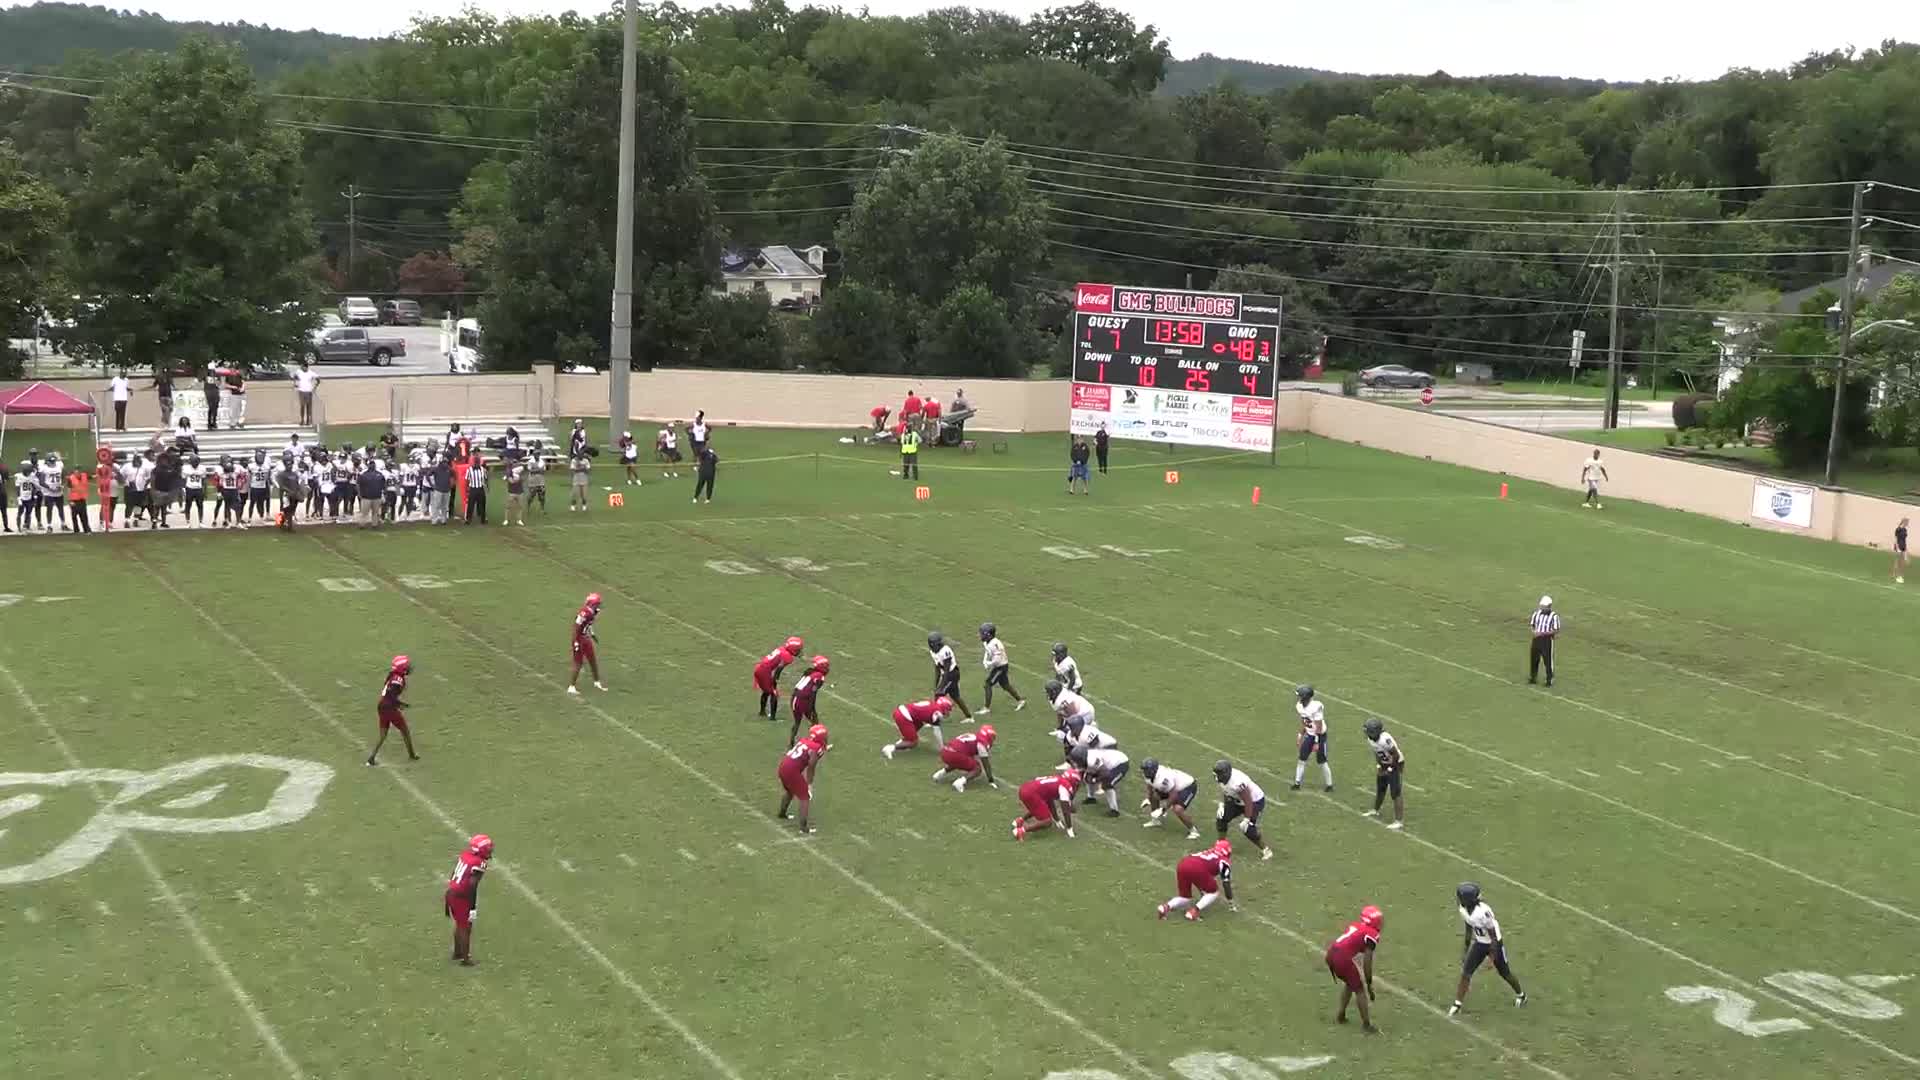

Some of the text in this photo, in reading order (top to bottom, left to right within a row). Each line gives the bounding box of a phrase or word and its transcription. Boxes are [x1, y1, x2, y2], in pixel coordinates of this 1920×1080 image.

[1119, 291, 1235, 316] GMC BULLDOGS
[1088, 316, 1129, 329] GUEST
[1155, 320, 1202, 344] 13:58
[1087, 328, 1092, 340] 1
[1109, 329, 1120, 350] 7
[1228, 326, 1258, 339] GMC
[1084, 352, 1112, 363] DOWN
[1230, 340, 1255, 361] 48
[1261, 341, 1270, 355] 3
[1130, 356, 1158, 366] TO GO
[1177, 360, 1219, 371] BALL ON
[1099, 363, 1104, 382] 1
[1139, 366, 1155, 386] 10
[1185, 369, 1209, 391] 25
[1243, 375, 1256, 395] 4
[1663, 970, 1904, 1038] 20
